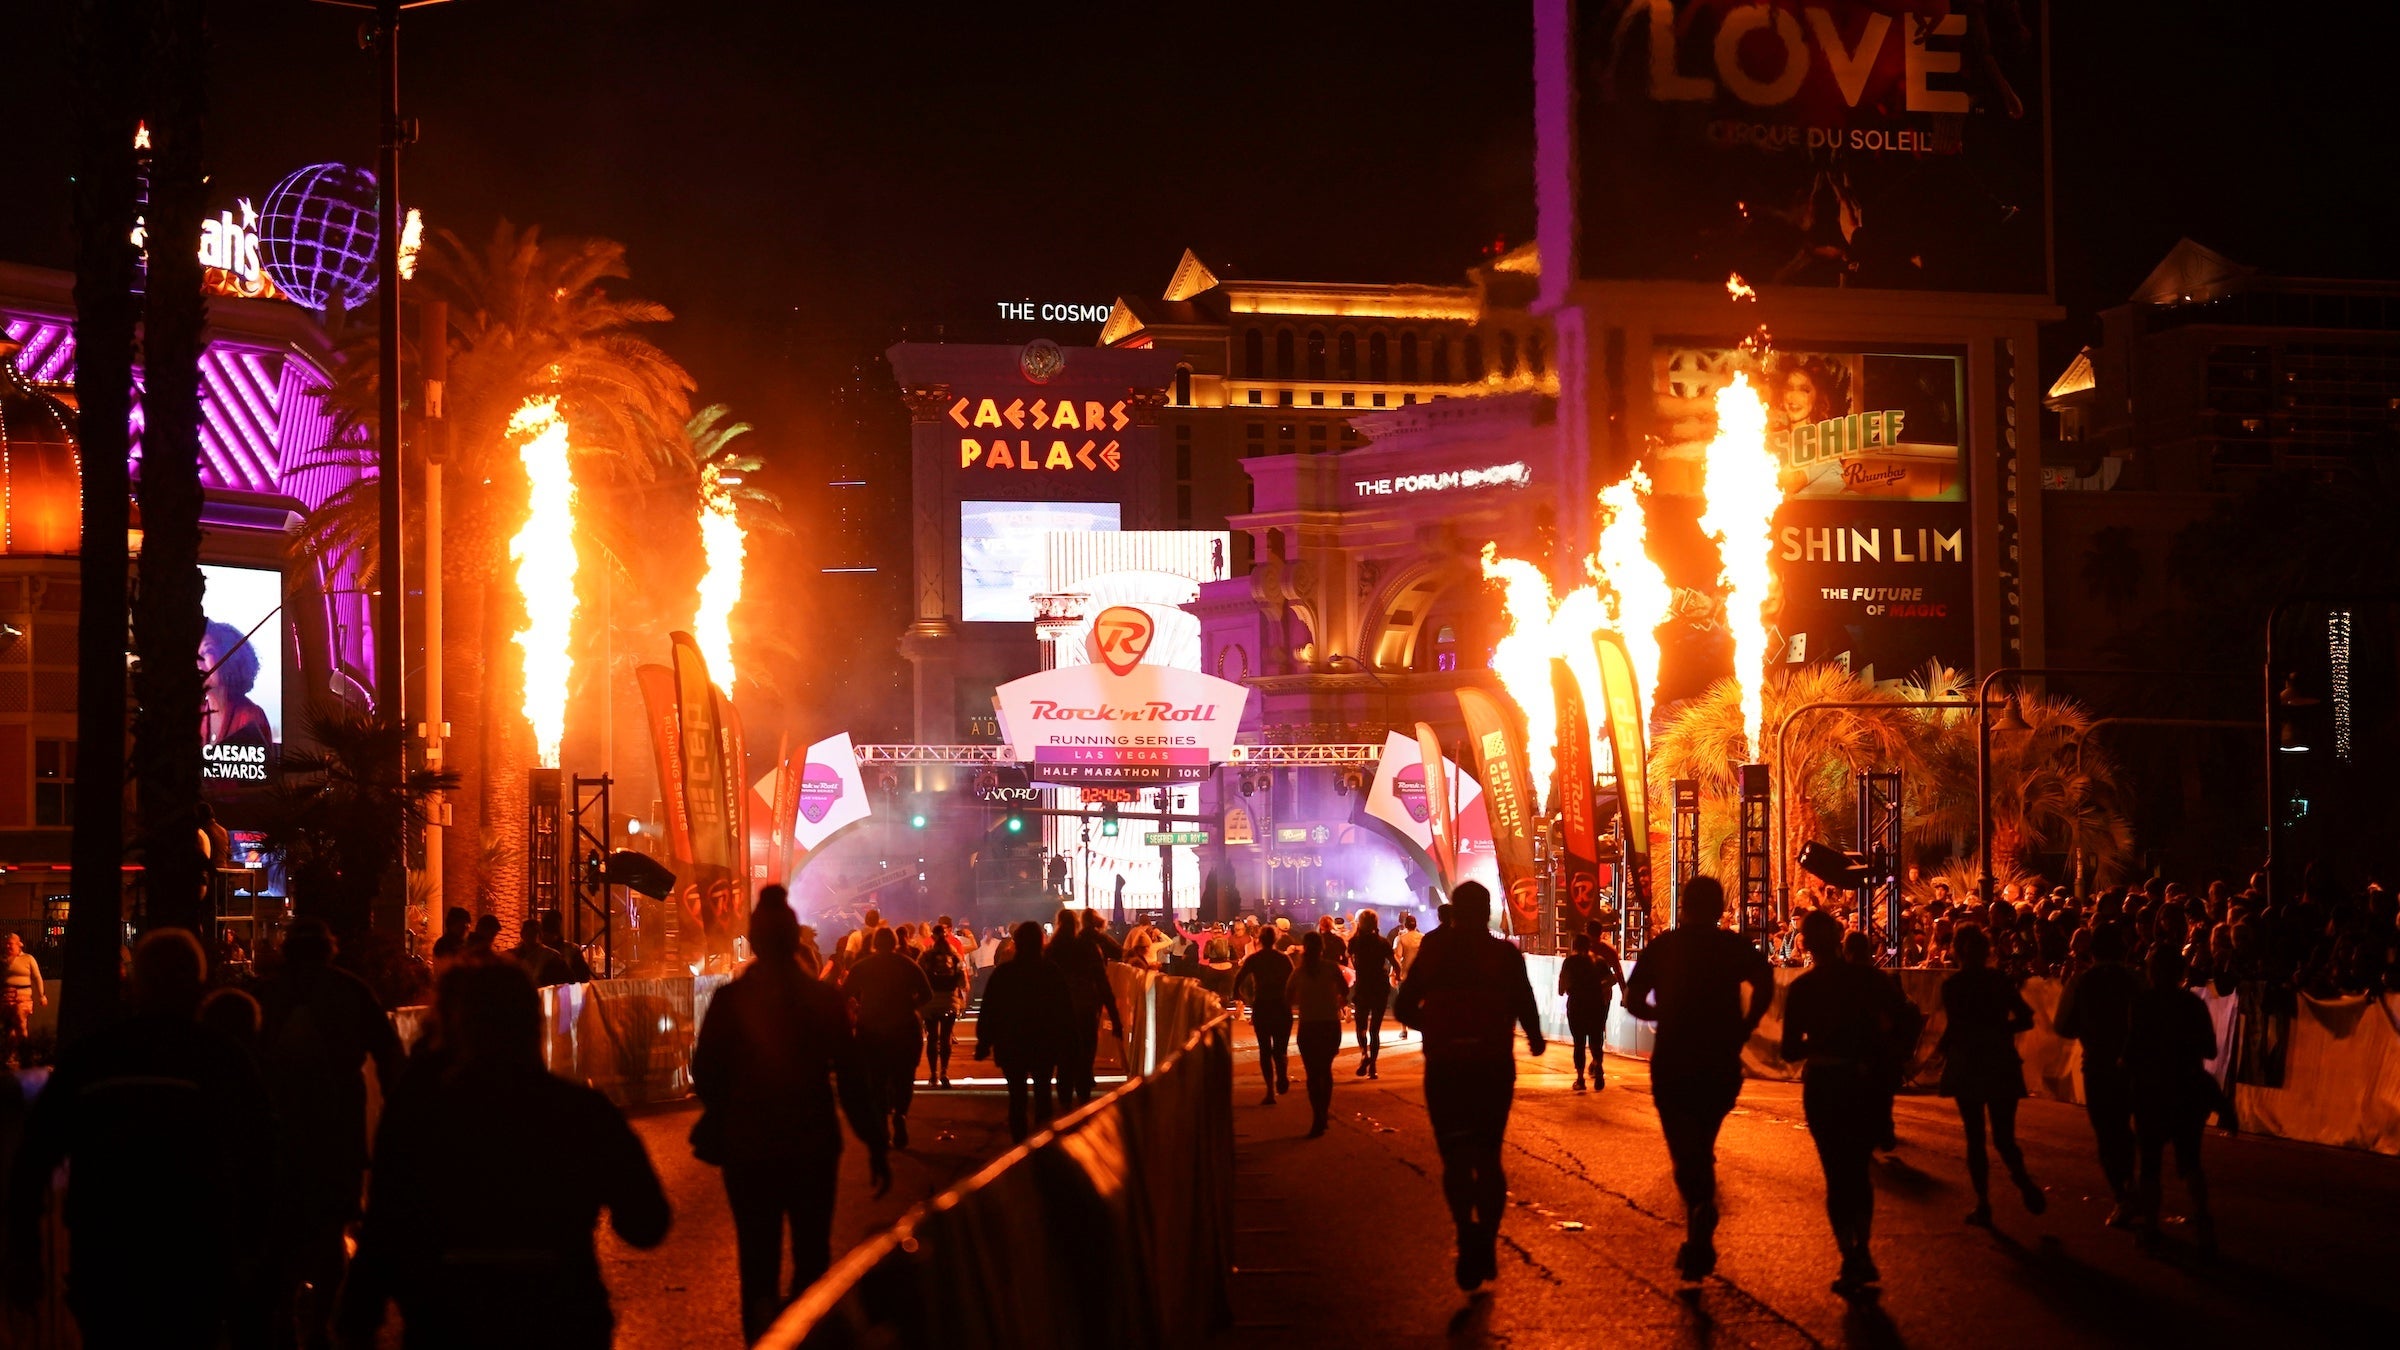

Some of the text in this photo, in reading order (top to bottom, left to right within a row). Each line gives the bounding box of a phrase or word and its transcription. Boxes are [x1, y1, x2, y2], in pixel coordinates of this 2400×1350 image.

[1640, 0, 1970, 113] LOVE
[1807, 128, 1843, 150] DU
[1850, 129, 1933, 152] SOLEIL
[997, 302, 1035, 320] THE
[948, 397, 1130, 432] CAESARS
[961, 438, 1121, 472] PALACE
[1355, 479, 1392, 496] THE
[1395, 472, 1459, 492] FORUM
[1780, 526, 1962, 562] SHIN LIM
[1821, 587, 1923, 601] THE FUTURE
[1866, 604, 1946, 617] OF MAGIC
[203, 744, 265, 763] CAESARS
[664, 715, 681, 779] RUNNING
[1050, 735, 1196, 745] RUNNING SERIES
[1074, 750, 1169, 760] LAS VEGAS
[1043, 767, 1078, 776] HALF
[1085, 768, 1159, 777] MARATHON
[1179, 769, 1200, 778] 10K
[674, 782, 689, 832] SERIES
[1490, 763, 1510, 826] UNITED
[1498, 760, 1524, 838] AIRLINES
[1563, 774, 1573, 822] SERIES
